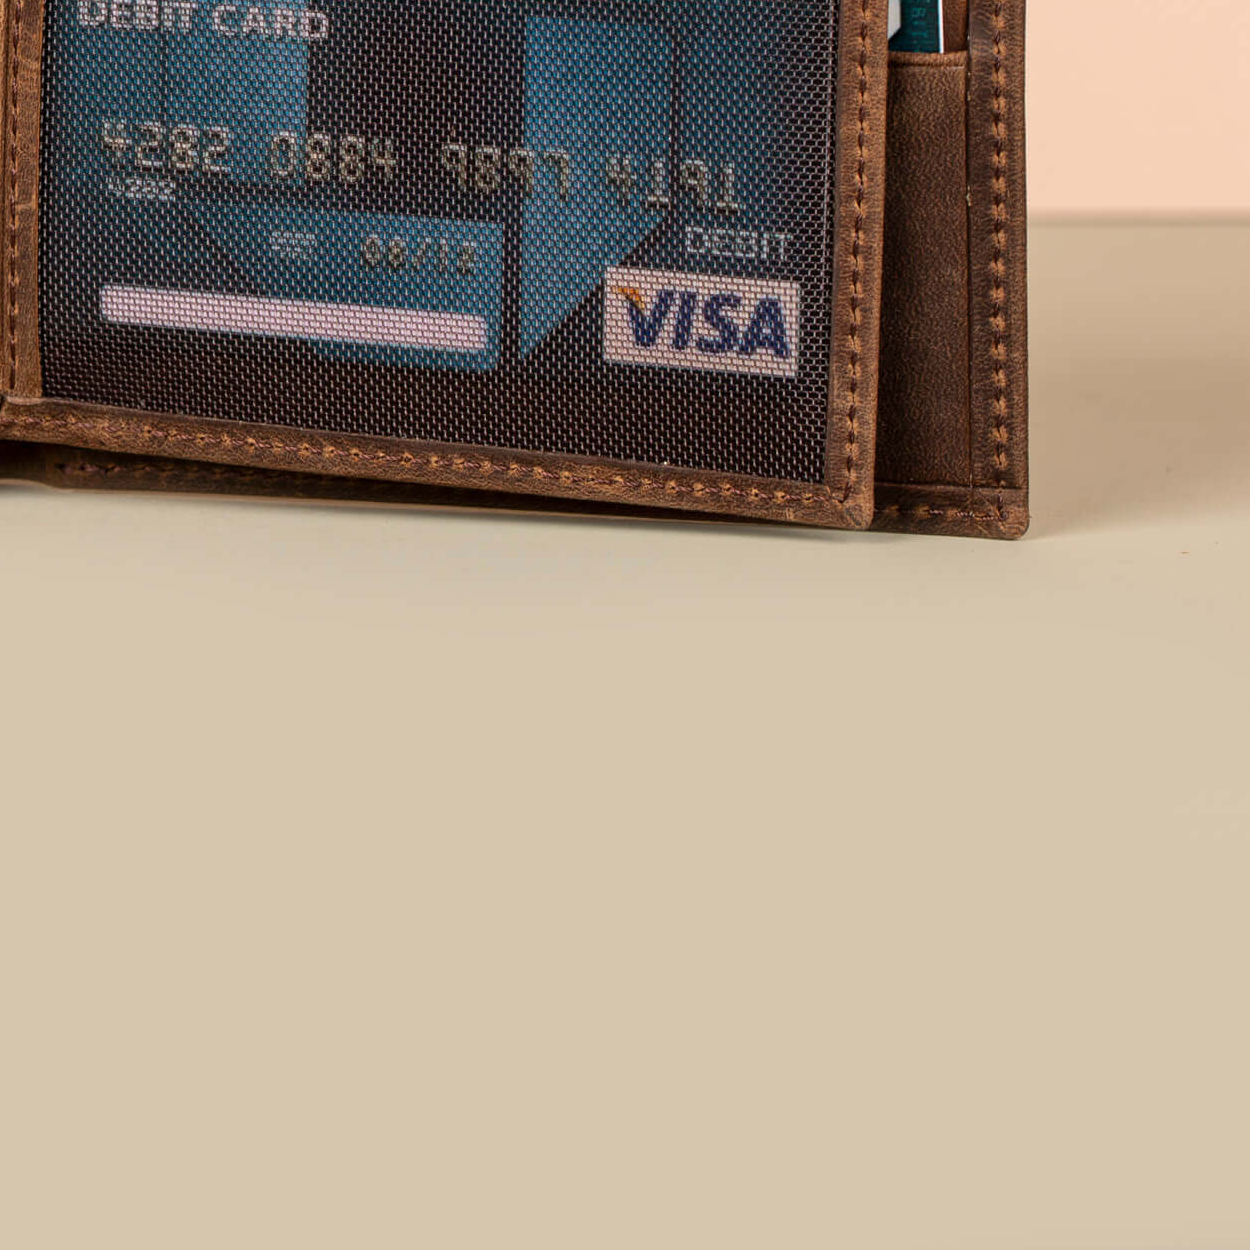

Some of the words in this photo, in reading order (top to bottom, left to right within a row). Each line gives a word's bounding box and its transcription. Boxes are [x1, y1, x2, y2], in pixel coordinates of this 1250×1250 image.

[210, 4, 329, 39] CARD
[102, 119, 231, 173] 4282
[685, 225, 793, 259] DEBIT
[610, 285, 791, 359] VISA
